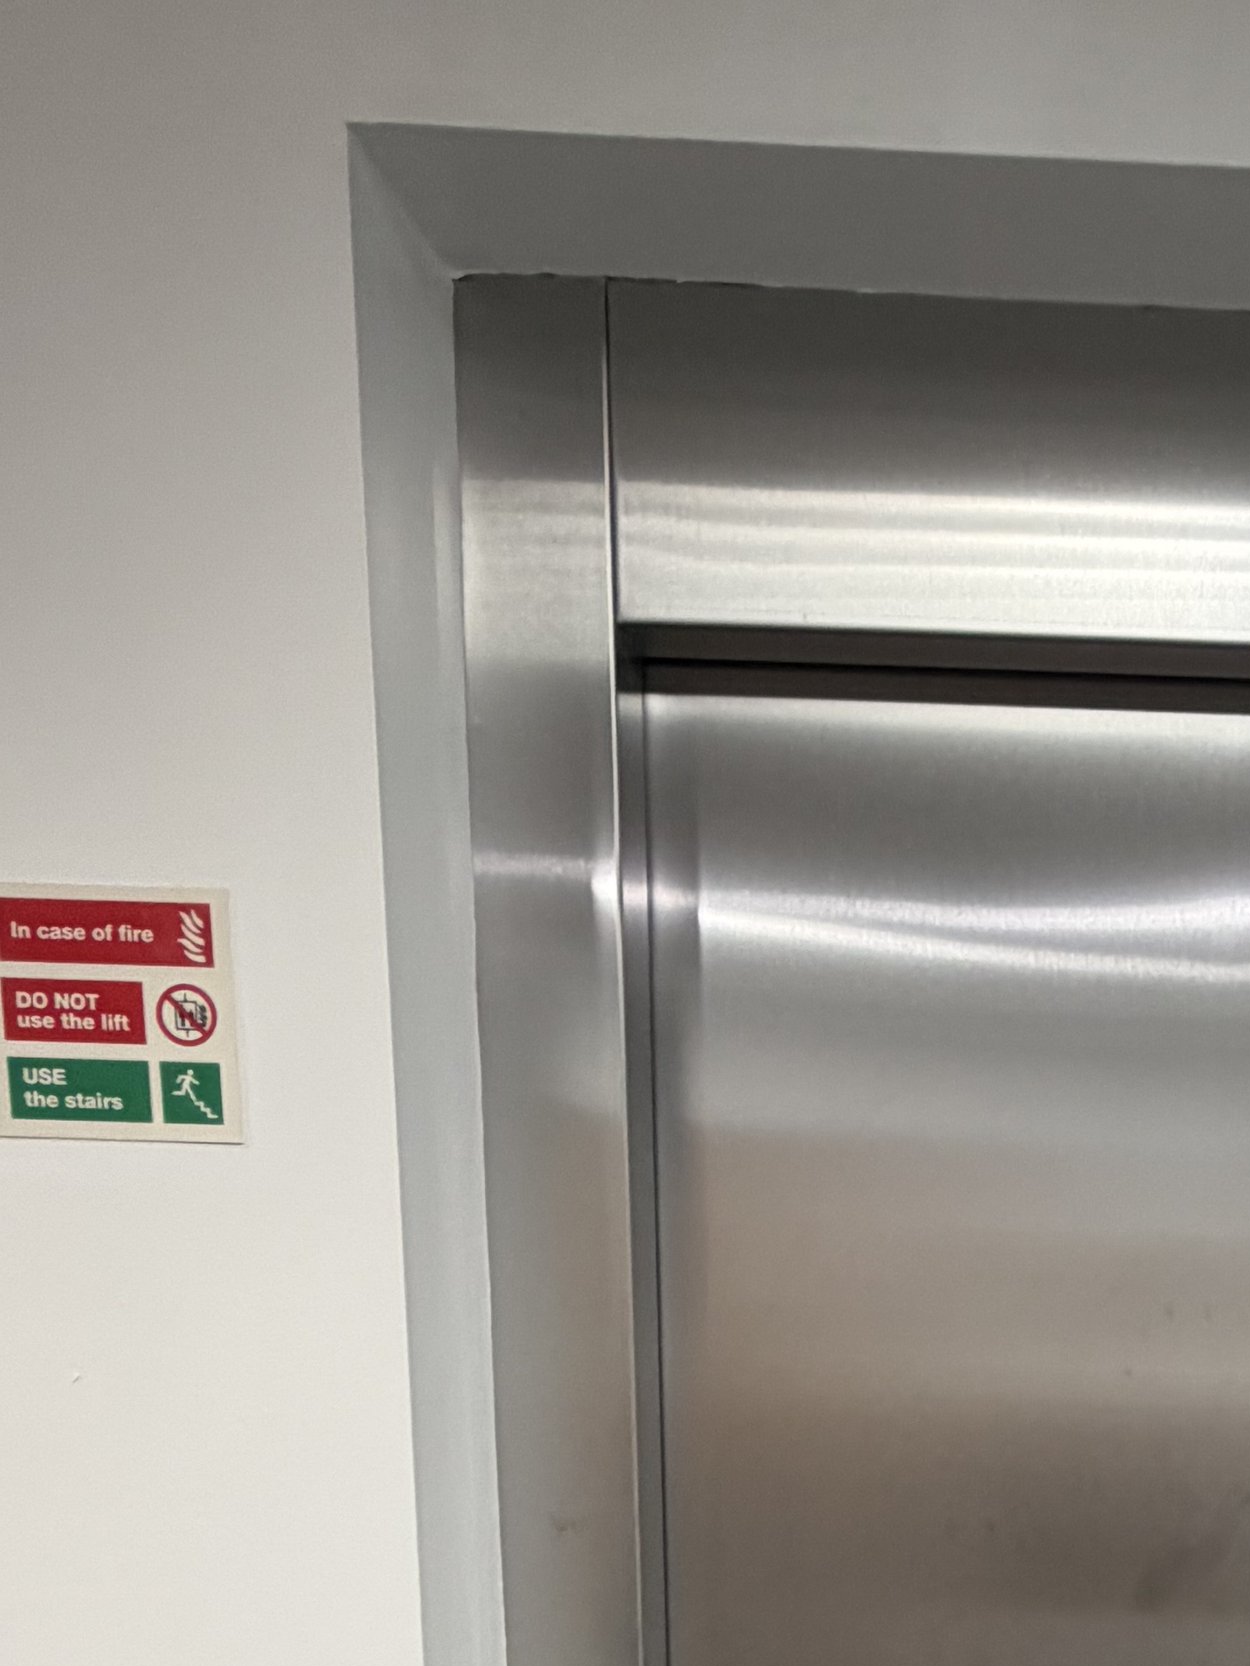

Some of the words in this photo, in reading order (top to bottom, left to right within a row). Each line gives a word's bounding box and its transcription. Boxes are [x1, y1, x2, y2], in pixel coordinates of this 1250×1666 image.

[10, 921, 31, 939] In
[36, 924, 86, 942] case
[91, 924, 113, 942] of
[118, 925, 155, 943] fire
[15, 991, 48, 1009] DO
[53, 993, 100, 1010] NOT
[17, 1015, 55, 1029] use
[60, 1013, 95, 1030] the
[100, 1014, 131, 1031] lift
[22, 1067, 68, 1086] USE
[23, 1091, 59, 1108] the
[65, 1093, 124, 1110] stairs
